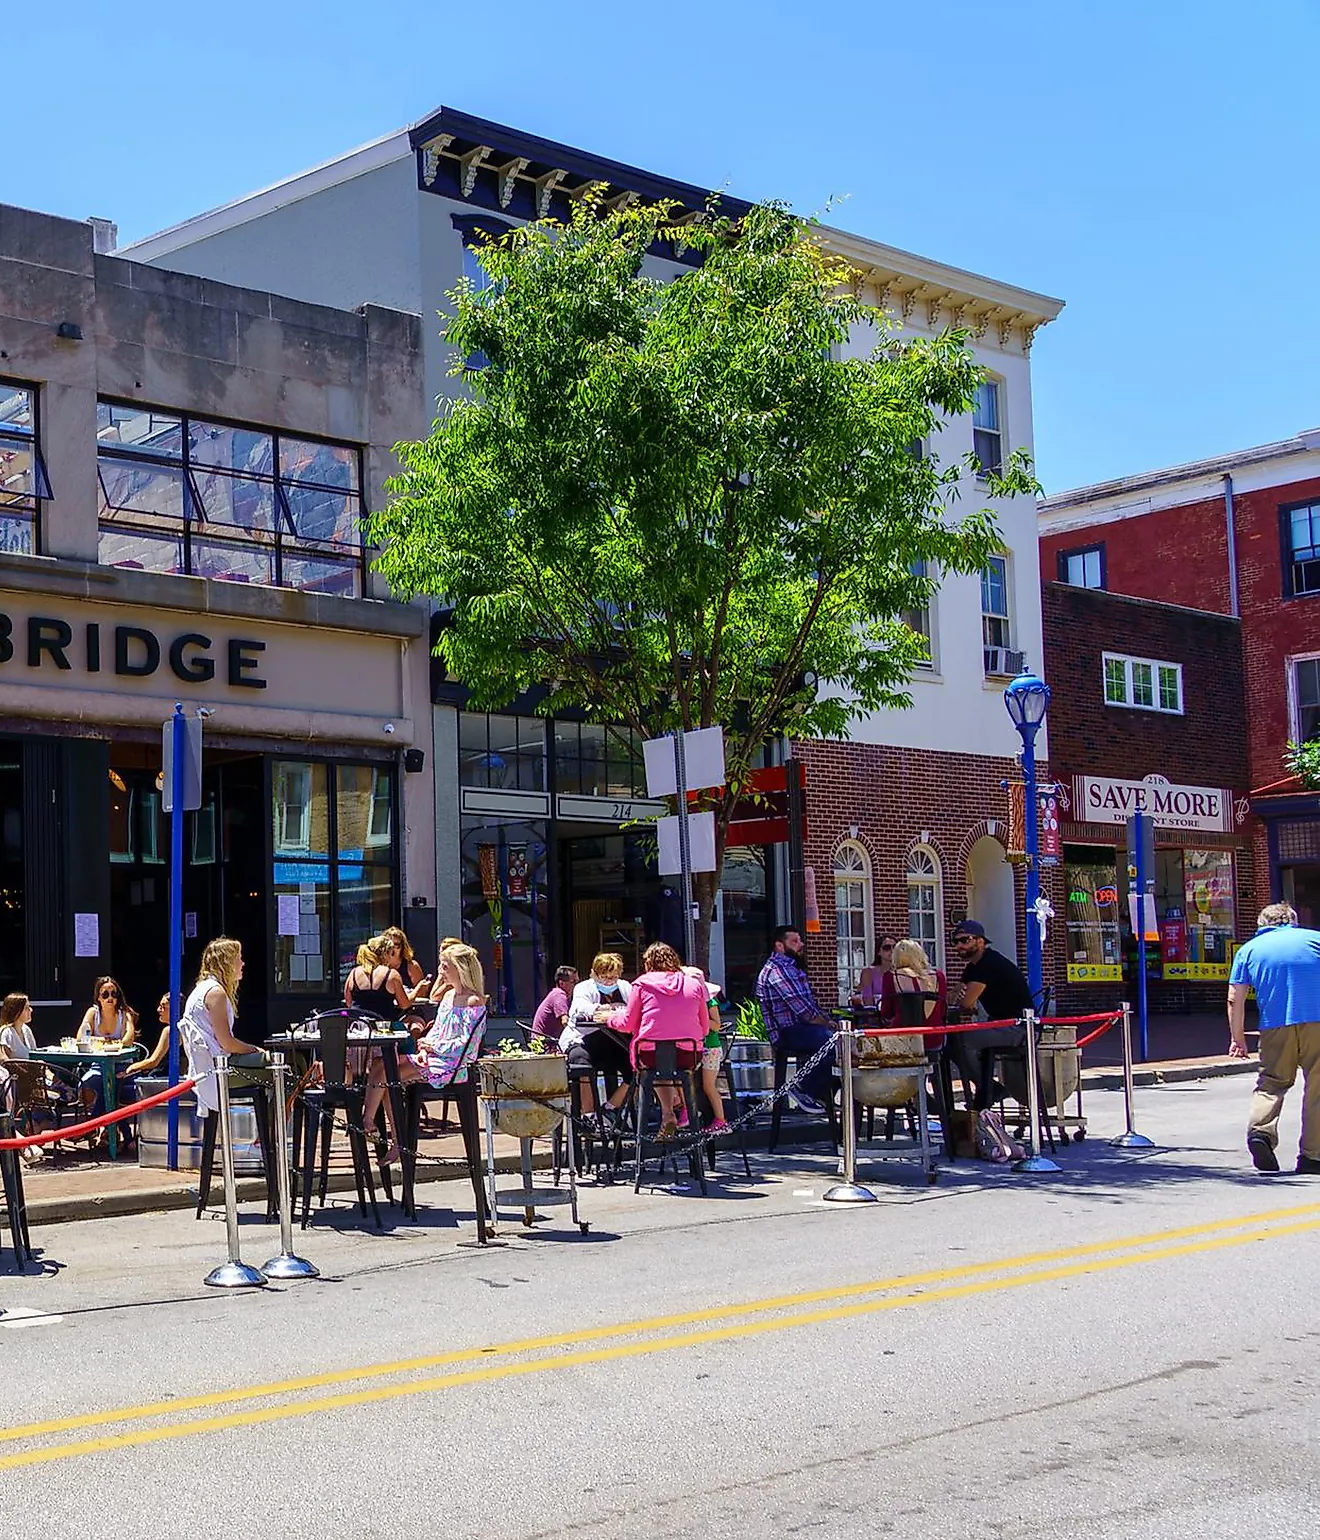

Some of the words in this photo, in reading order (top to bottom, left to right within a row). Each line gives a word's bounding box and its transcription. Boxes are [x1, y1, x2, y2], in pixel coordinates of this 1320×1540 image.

[1147, 776, 1165, 785] 218
[1089, 783, 1148, 812] SAVE
[1153, 789, 1220, 818] MORE
[612, 803, 632, 818] 214
[1169, 818, 1200, 828] STORE
[1069, 892, 1088, 903] ATM
[1095, 890, 1118, 902] OPEN
